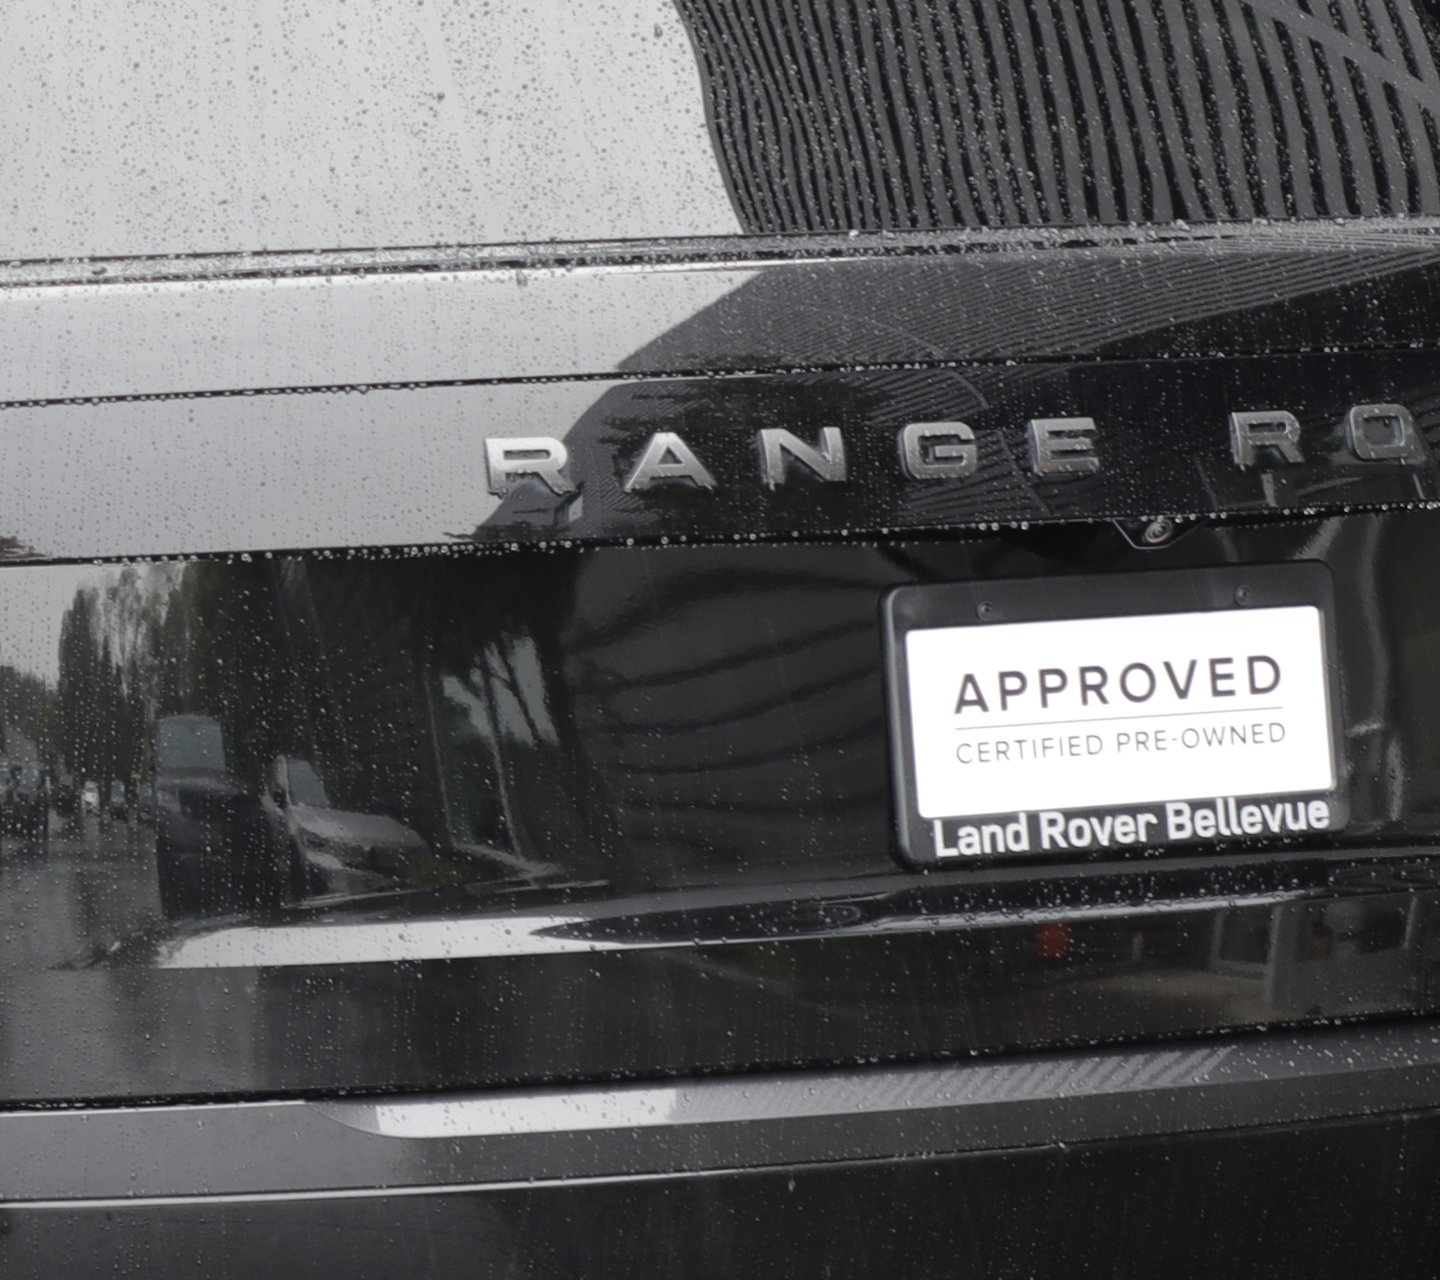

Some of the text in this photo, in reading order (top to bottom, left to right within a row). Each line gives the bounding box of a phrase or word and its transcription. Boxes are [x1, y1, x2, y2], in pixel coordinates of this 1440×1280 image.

[484, 416, 1101, 496] RANGE
[953, 654, 1282, 715] APPROVED
[955, 722, 1287, 765] CERTIFIED PRE-OWNED
[933, 797, 1331, 858] Land Rover Bellevue
